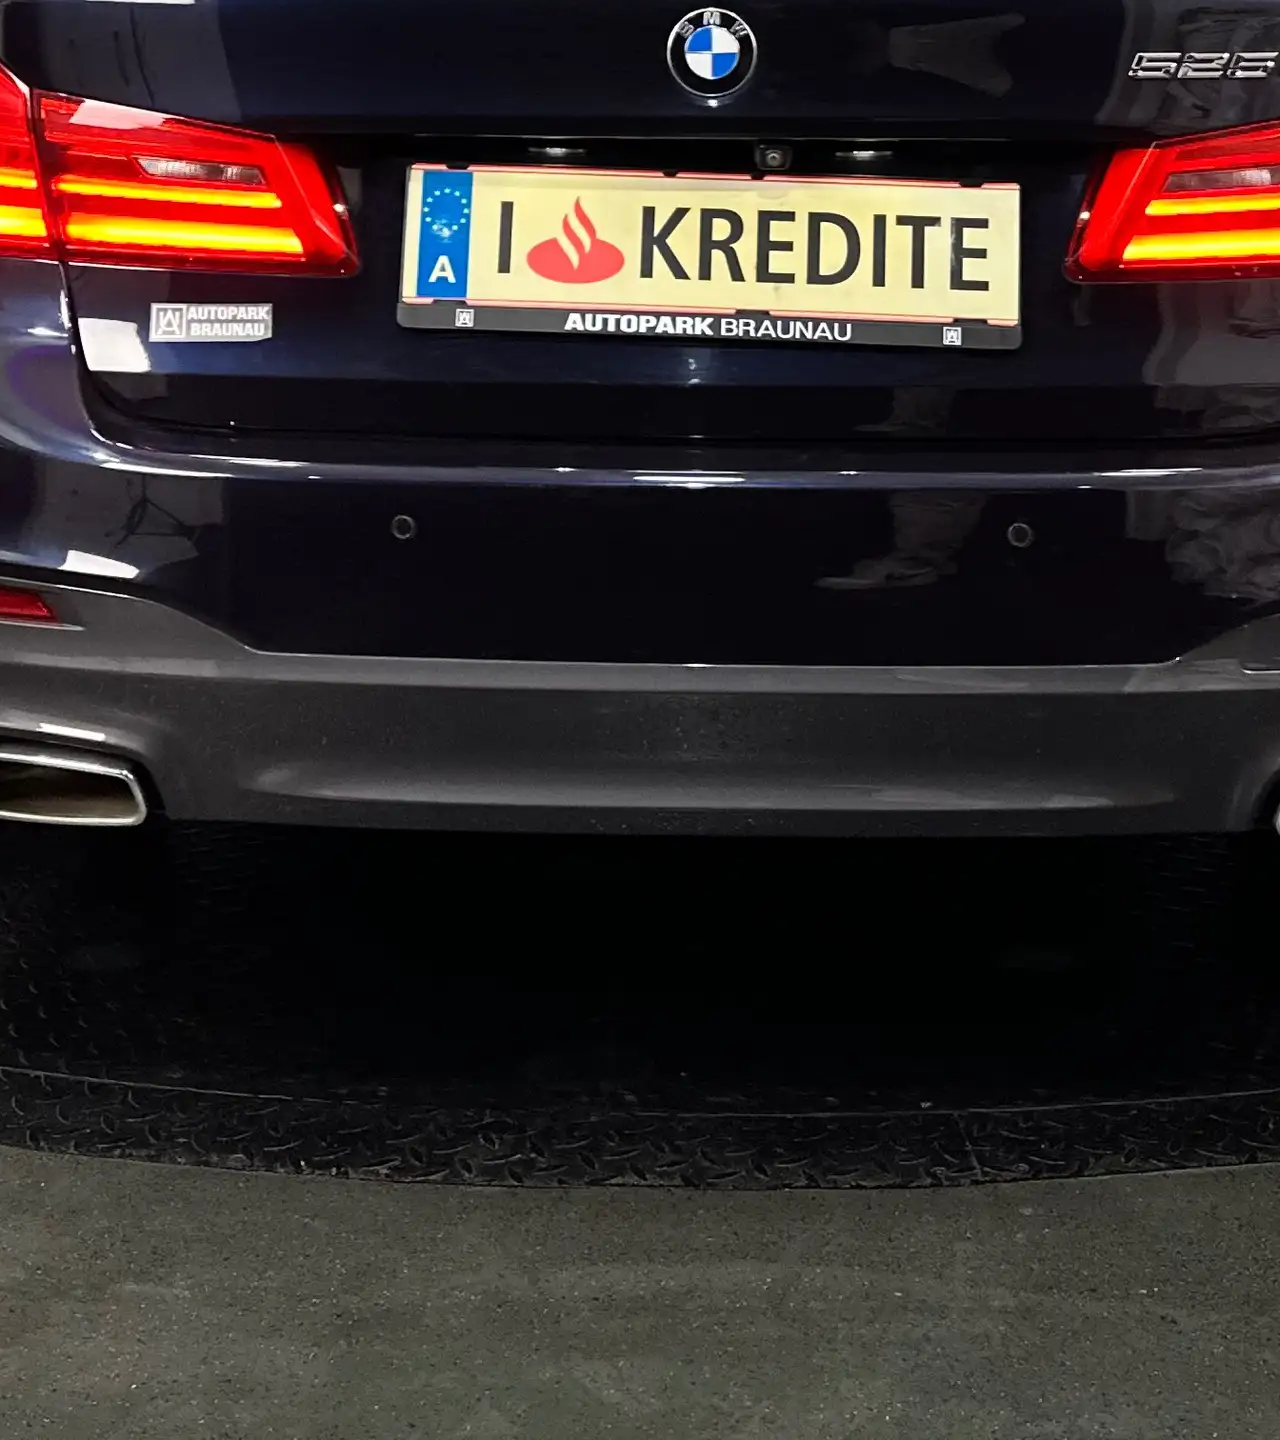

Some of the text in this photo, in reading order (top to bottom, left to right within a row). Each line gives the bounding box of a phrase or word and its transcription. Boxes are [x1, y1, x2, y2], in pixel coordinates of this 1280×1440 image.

[639, 204, 991, 292] KREDITE
[428, 254, 457, 284] A
[187, 306, 269, 320] AUTOPARK
[564, 311, 853, 342] AUTOPARK BRAUNAU
[189, 322, 266, 336] BRAUNAU
